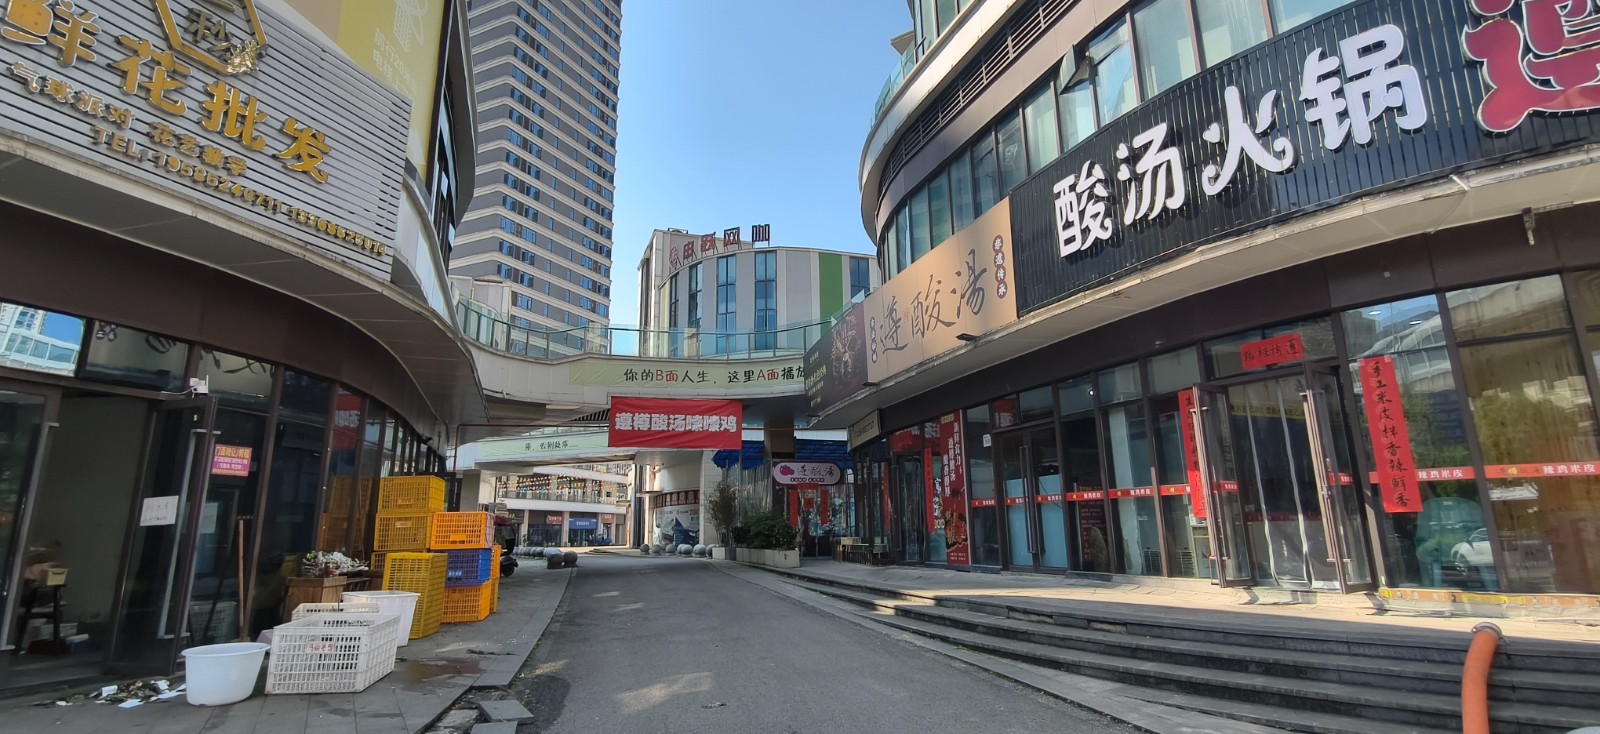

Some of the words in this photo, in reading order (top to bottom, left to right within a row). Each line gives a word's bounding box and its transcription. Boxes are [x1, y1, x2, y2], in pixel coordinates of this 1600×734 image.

[1, 0, 332, 184] 鲜花批发
[7, 60, 135, 130] 气球派对
[147, 121, 249, 177] 花艺教学
[1052, 23, 1428, 258] 酸汤火锅
[993, 236, 1008, 298] 非遗传承
[1418, 469, 1464, 479] 辣鸡米皮
[1542, 463, 1596, 475] 辣鸡米皮
